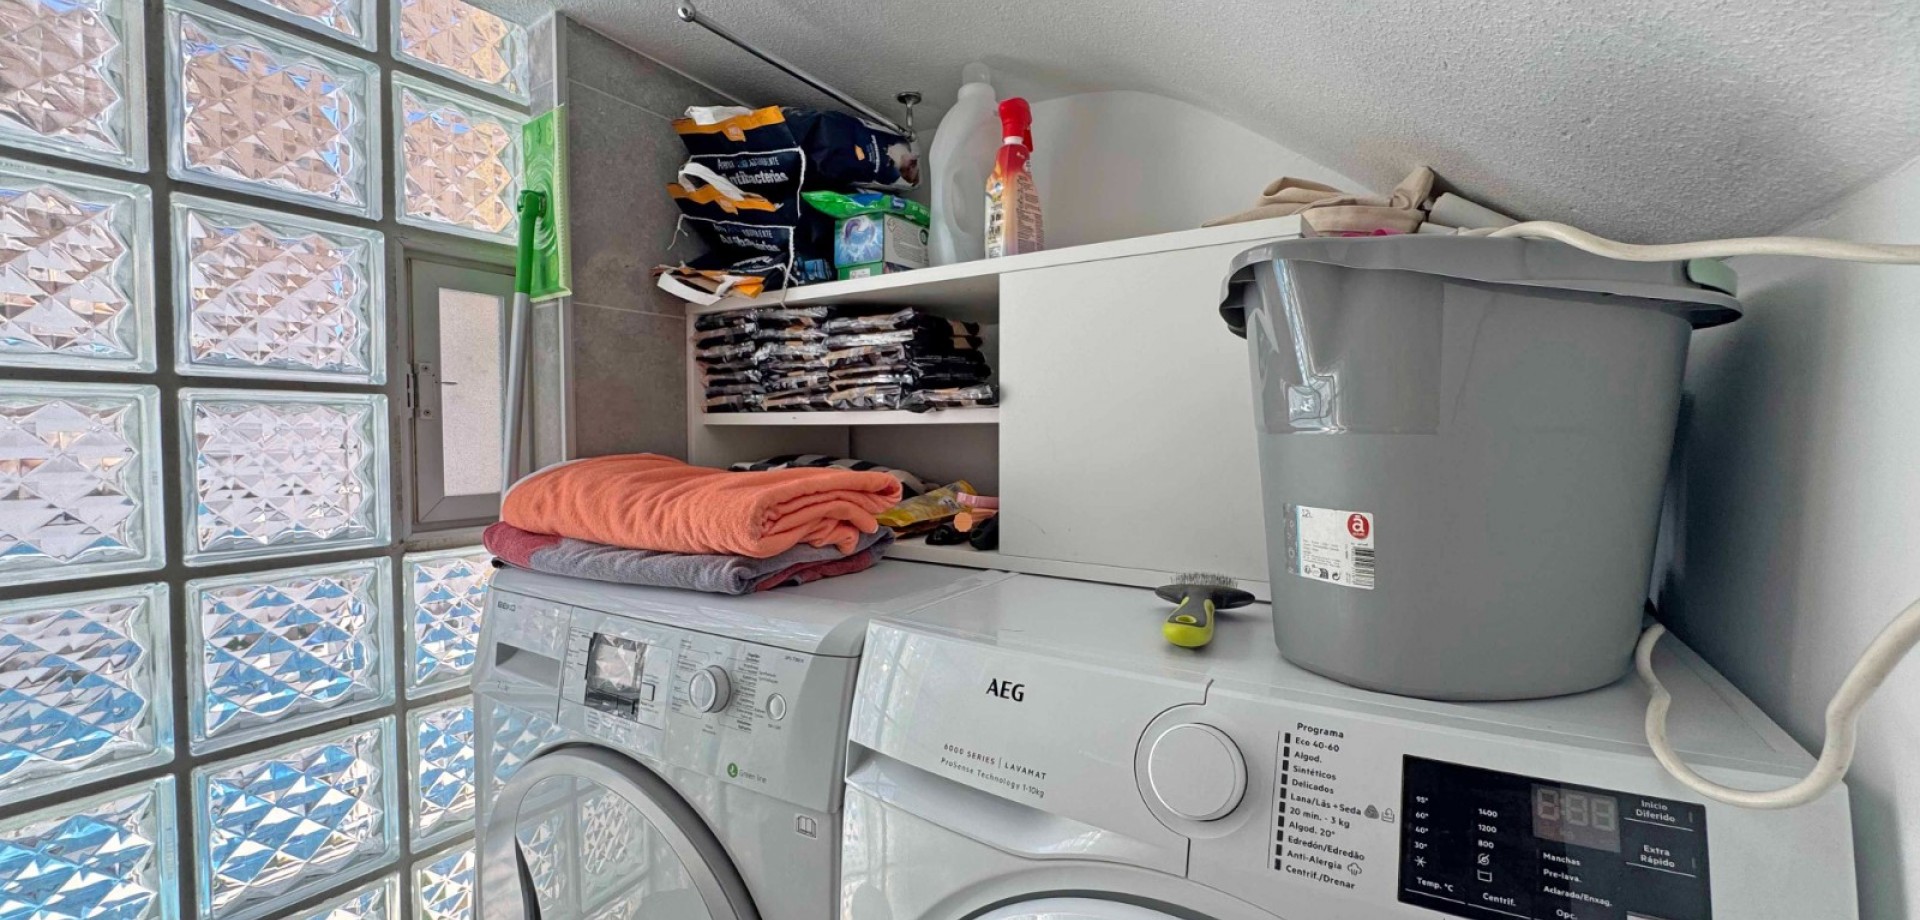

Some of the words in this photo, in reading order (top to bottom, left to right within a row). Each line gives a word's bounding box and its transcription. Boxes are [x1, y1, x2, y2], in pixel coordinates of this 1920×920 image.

[985, 678, 1025, 702] AEG
[1297, 722, 1344, 738] Programa
[1295, 736, 1310, 747] Eco
[1313, 740, 1340, 753] 40-60
[943, 744, 964, 755] 6000
[966, 751, 996, 765] SERIES
[1004, 762, 1047, 780] LAVAMAT
[1294, 751, 1322, 763] Algod.
[940, 757, 974, 774] ProSense
[977, 769, 1021, 790] Technology
[1293, 765, 1337, 780] Sintéticos
[1291, 778, 1334, 794] Delicados
[1289, 806, 1301, 816] 20
[1302, 811, 1322, 821] min.
[1330, 816, 1336, 824] 3
[1338, 818, 1350, 829] kg
[1477, 808, 1498, 818] 1400
[1635, 808, 1676, 823] Diferido
[1288, 821, 1318, 834] Algod.
[1477, 824, 1497, 833] 1200
[1477, 839, 1495, 849] 800
[1643, 844, 1671, 857] Extra
[1286, 850, 1343, 870] Anti-Alergia
[1542, 852, 1582, 867] Manchas
[1640, 854, 1676, 868] Rápido
[1286, 864, 1356, 889] Centrif./Drenar
[1416, 876, 1443, 890] Temp.
[1542, 868, 1583, 883] Pre-lava.
[1482, 892, 1517, 907] Centrif.
[1555, 908, 1578, 920] Opc.
